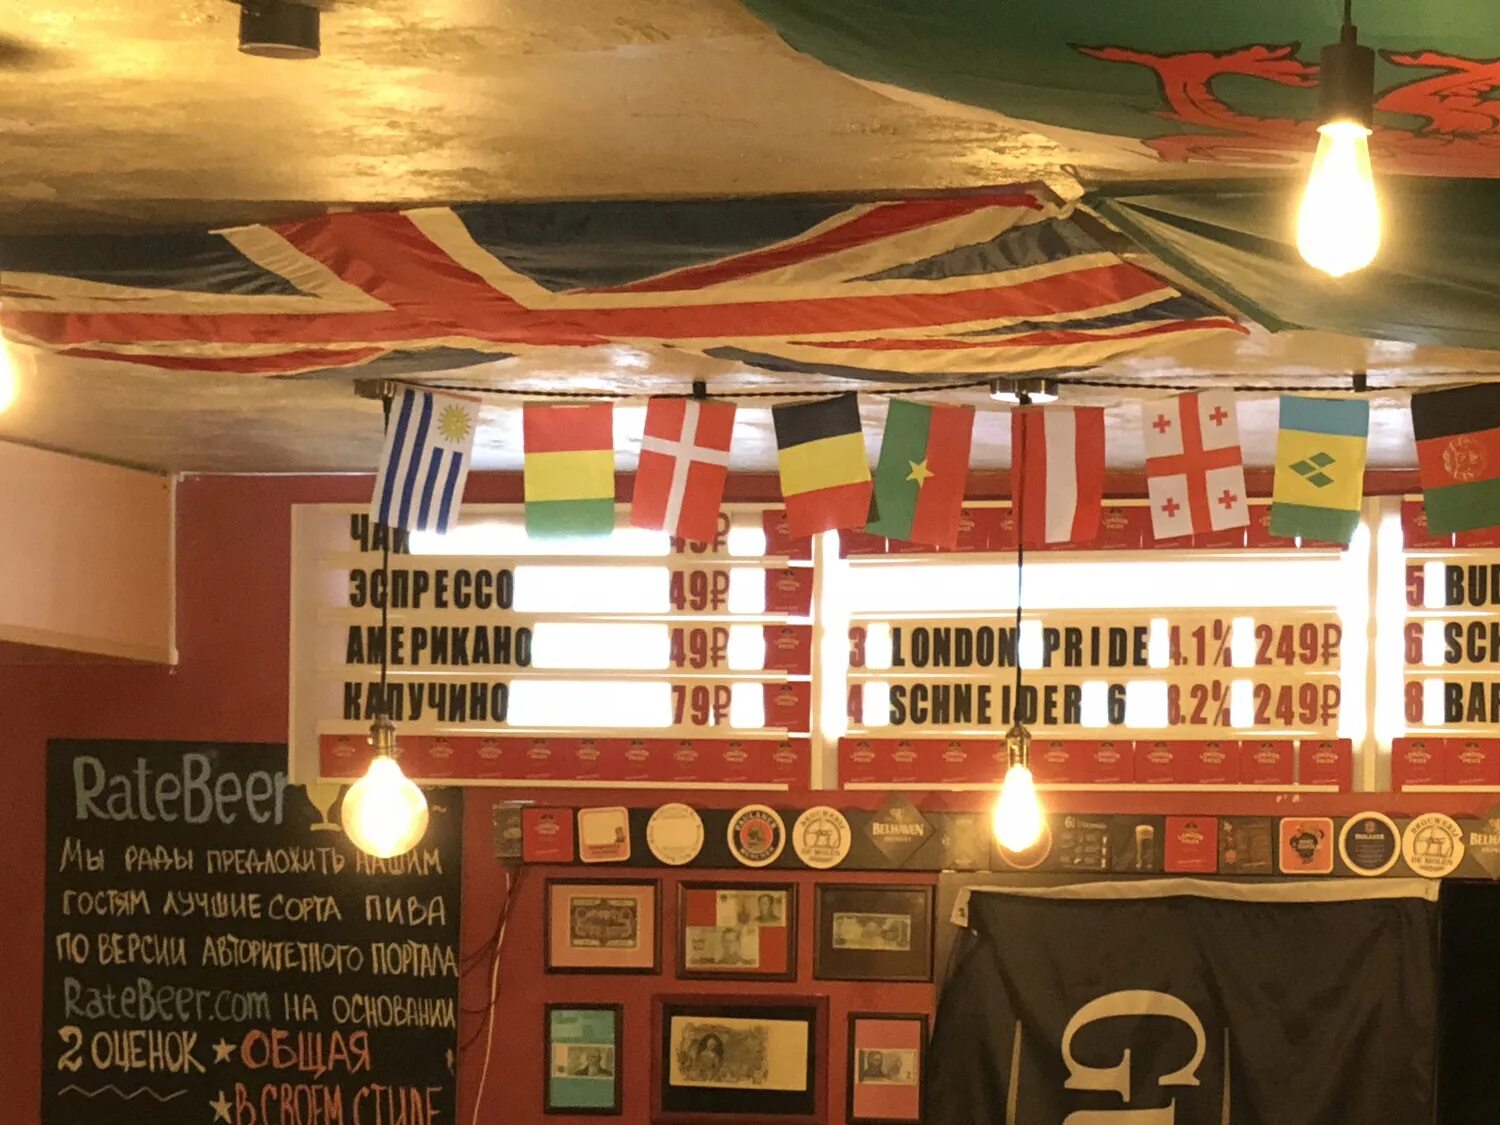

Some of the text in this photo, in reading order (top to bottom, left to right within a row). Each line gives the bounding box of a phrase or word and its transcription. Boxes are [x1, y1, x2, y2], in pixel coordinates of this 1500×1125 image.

[349, 568, 730, 613] ЭСПРЕССО 49₽
[1405, 562, 1425, 604] 5
[345, 625, 730, 669] АМЕРИКАНО 49₽
[849, 618, 1341, 668] 3 LONDON PRIDE 4.1% 249₽
[1404, 622, 1423, 664] 6
[343, 680, 732, 727] КАПУЧИНО 79₽
[847, 684, 863, 726] 4
[889, 684, 1083, 726] SCHNEIDER
[1107, 683, 1126, 725] 6
[1253, 683, 1341, 725] 249₽
[1404, 682, 1424, 724] 8
[73, 753, 289, 825] RateBeer
[872, 823, 924, 836] BELHAVEN
[59, 836, 105, 872] Мы
[162, 892, 262, 919] ЛУЧШИЕ
[267, 896, 342, 922] СОРТА
[364, 893, 447, 927] ПИВА
[56, 931, 460, 979] ПО ВЕРСИИ АВТОРИТЕТНОГО ПОРТАЛА
[63, 976, 456, 1030] RateBeer.com НА ОСНОВАНИИ
[58, 1025, 371, 1079] 2 ОЦЕНОК ОБЩАЯ
